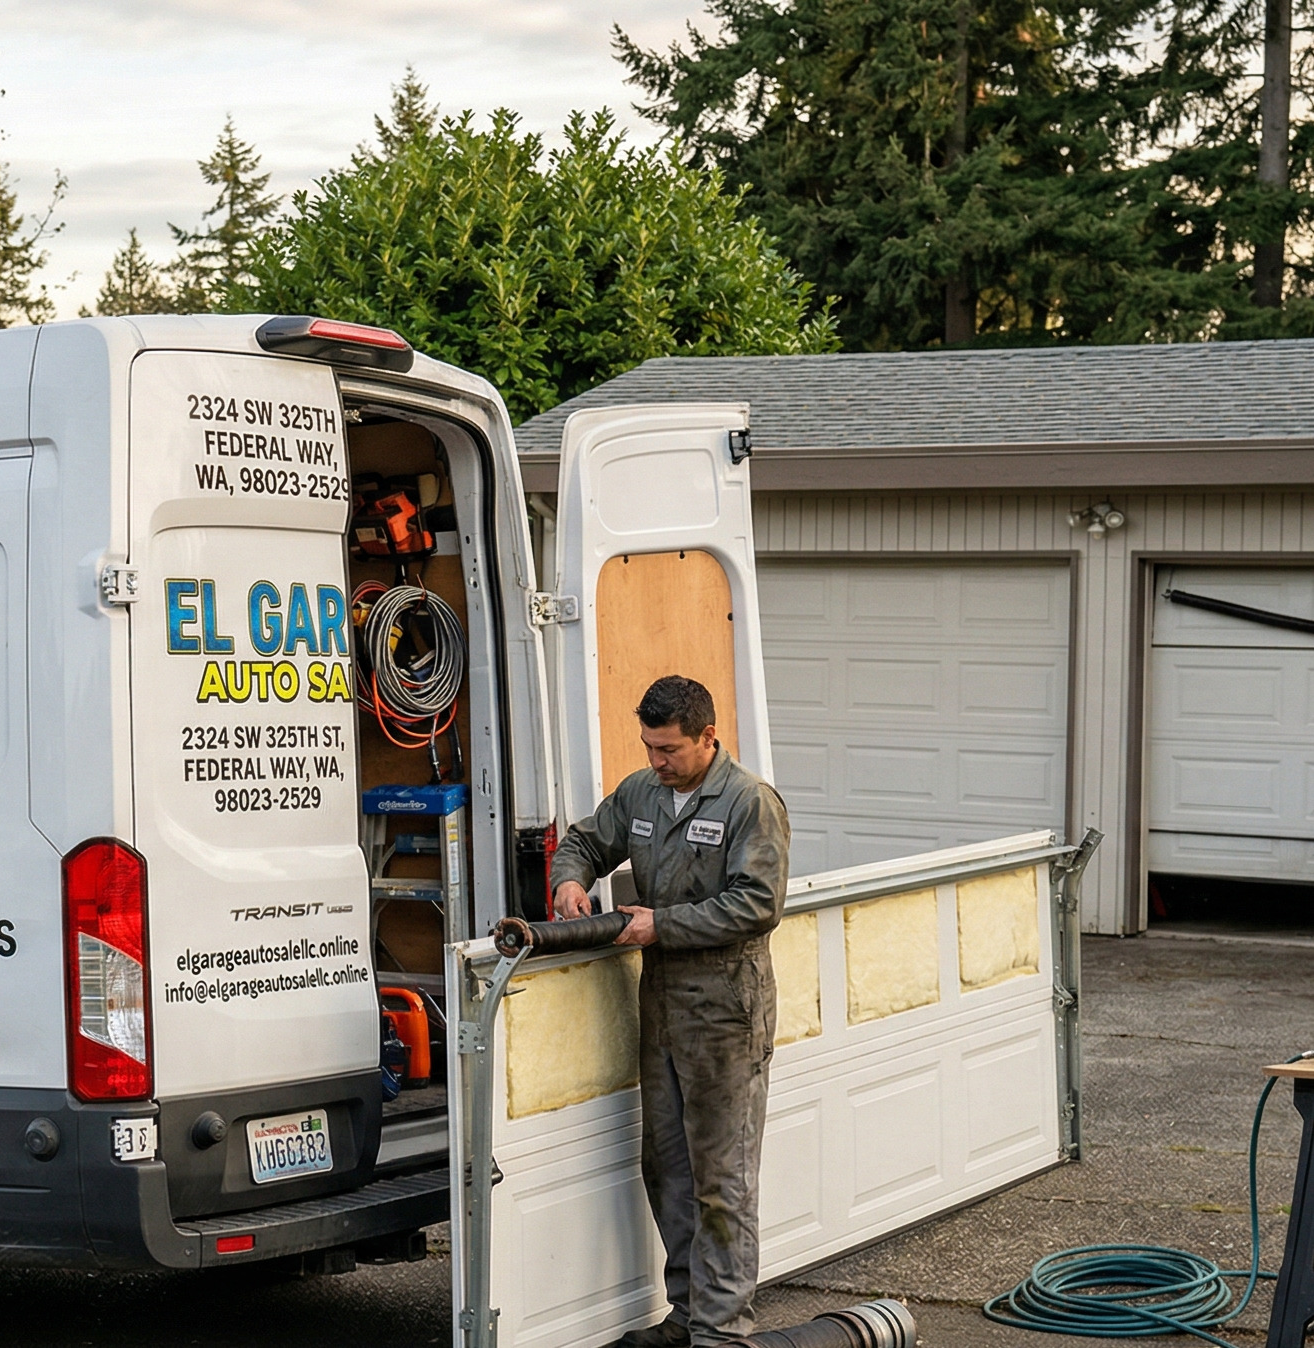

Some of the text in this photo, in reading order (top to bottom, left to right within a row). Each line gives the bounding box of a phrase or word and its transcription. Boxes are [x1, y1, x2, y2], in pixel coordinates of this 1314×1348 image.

[187, 394, 336, 434] 2324 SW 325TH
[205, 430, 338, 472] FEDERAL WAY,
[195, 464, 349, 501] WA, 98023-2529
[164, 578, 350, 657] EL GAR
[196, 660, 354, 703] AUTO SA
[182, 726, 345, 751] 2324 SW 325TH ST,
[185, 756, 345, 782] FEDERAL WAY, WA,
[215, 786, 321, 812] 98023-2529
[230, 902, 324, 921] TRANSIT
[177, 935, 359, 975] elgarageautosalellc.online
[165, 964, 369, 1004] info@elgarageautosalellc.online
